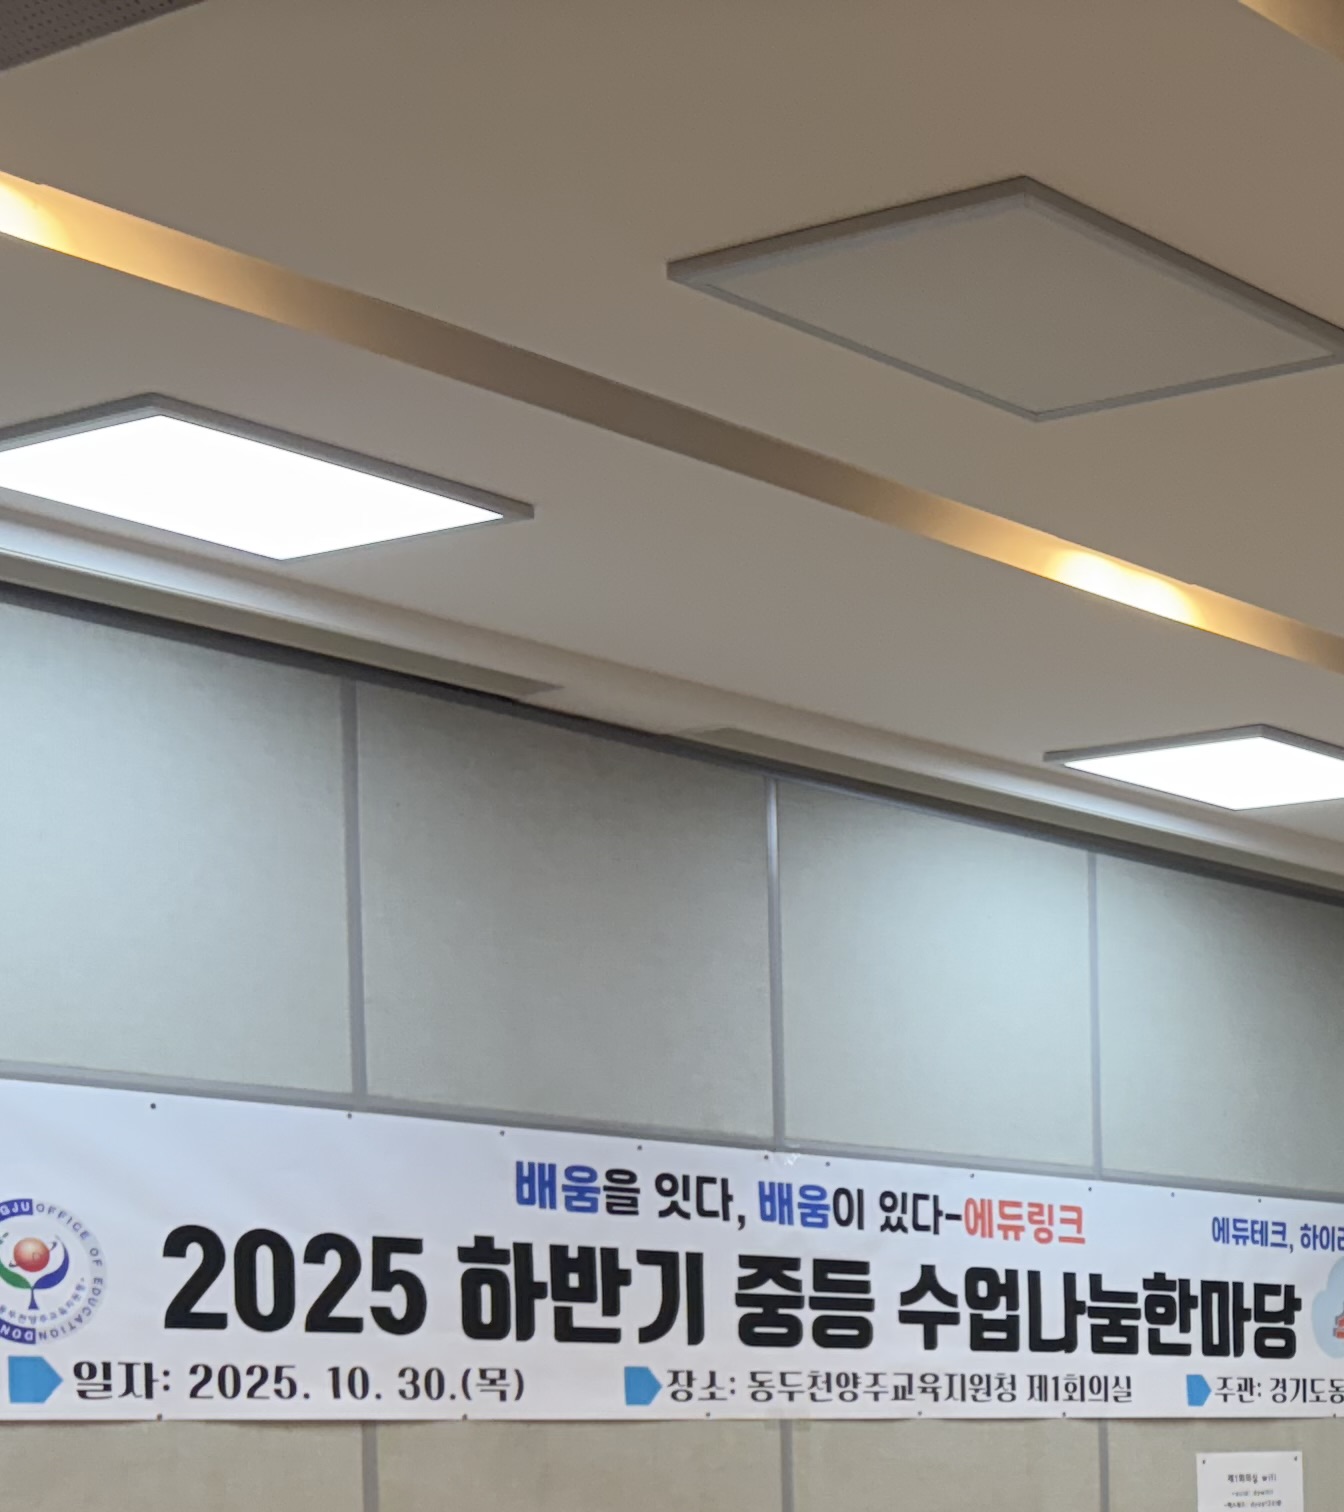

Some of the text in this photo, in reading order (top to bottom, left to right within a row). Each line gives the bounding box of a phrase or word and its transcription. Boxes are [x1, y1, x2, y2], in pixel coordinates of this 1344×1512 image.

[36, 1203, 90, 1240] OFFICE
[515, 1160, 1086, 1245] 배움을 잇다, 배움이 있다-에듀링크
[1211, 1216, 1294, 1254] 에듀테크,
[90, 1247, 103, 1267] OF
[39, 1277, 103, 1340] EDUCATION
[162, 1224, 1303, 1358] 2025 하반기 중등 수업나눔한마당
[72, 1362, 524, 1404] 일자: 2025. 10. 30.(목)
[666, 1369, 1133, 1404] 장소: 동두천양주교육지원청 제1회의실
[1214, 1376, 1262, 1404] 주관:
